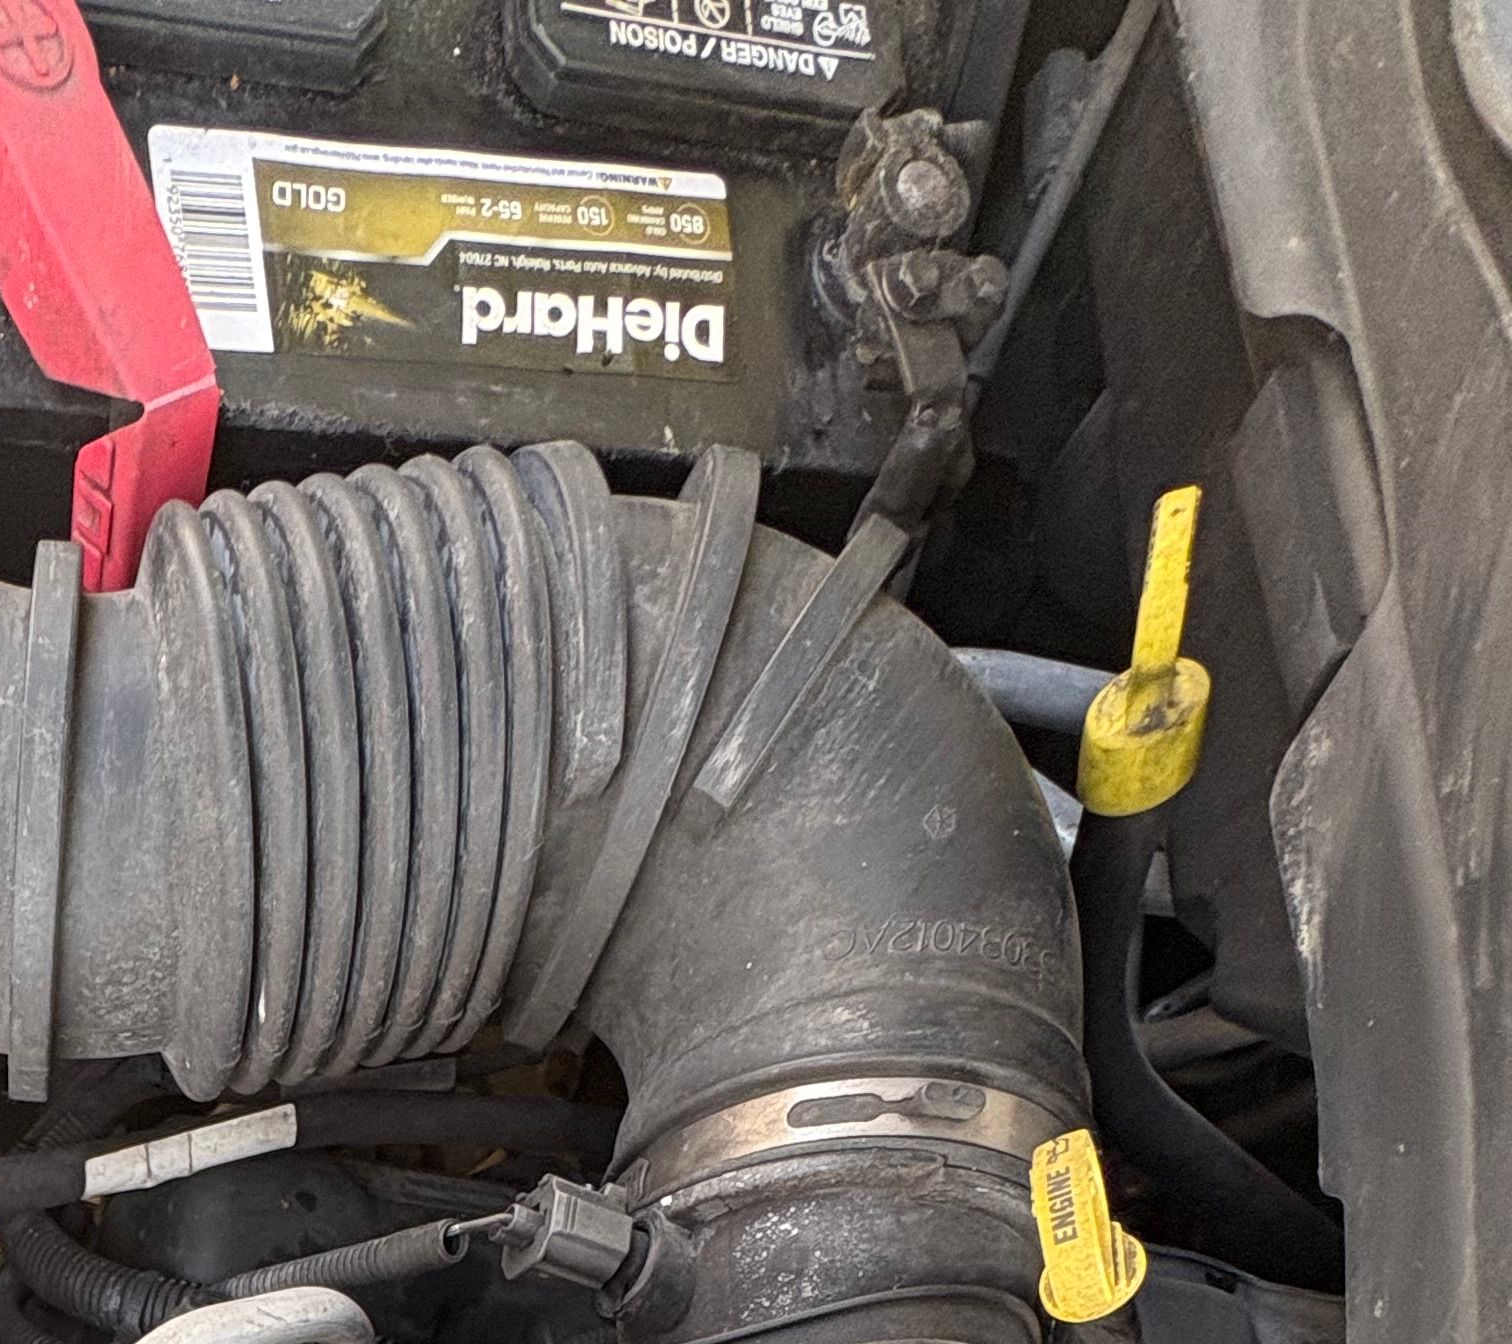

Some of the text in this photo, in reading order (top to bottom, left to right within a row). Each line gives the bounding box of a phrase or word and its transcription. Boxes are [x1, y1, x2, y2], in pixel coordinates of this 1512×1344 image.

[609, 20, 816, 76] DANGER / POISON
[596, 172, 658, 188] WARNING:
[273, 181, 346, 213] GOLD
[480, 197, 523, 220] 65-2
[576, 206, 609, 226] 150
[669, 212, 706, 234] 850
[494, 254, 510, 268] NC
[552, 257, 582, 273] Parts,
[583, 261, 608, 275] Auto
[609, 261, 652, 278] Advance
[669, 267, 724, 284] Distributed
[462, 286, 725, 363] DieHard
[1046, 1166, 1079, 1247] ENGINE
